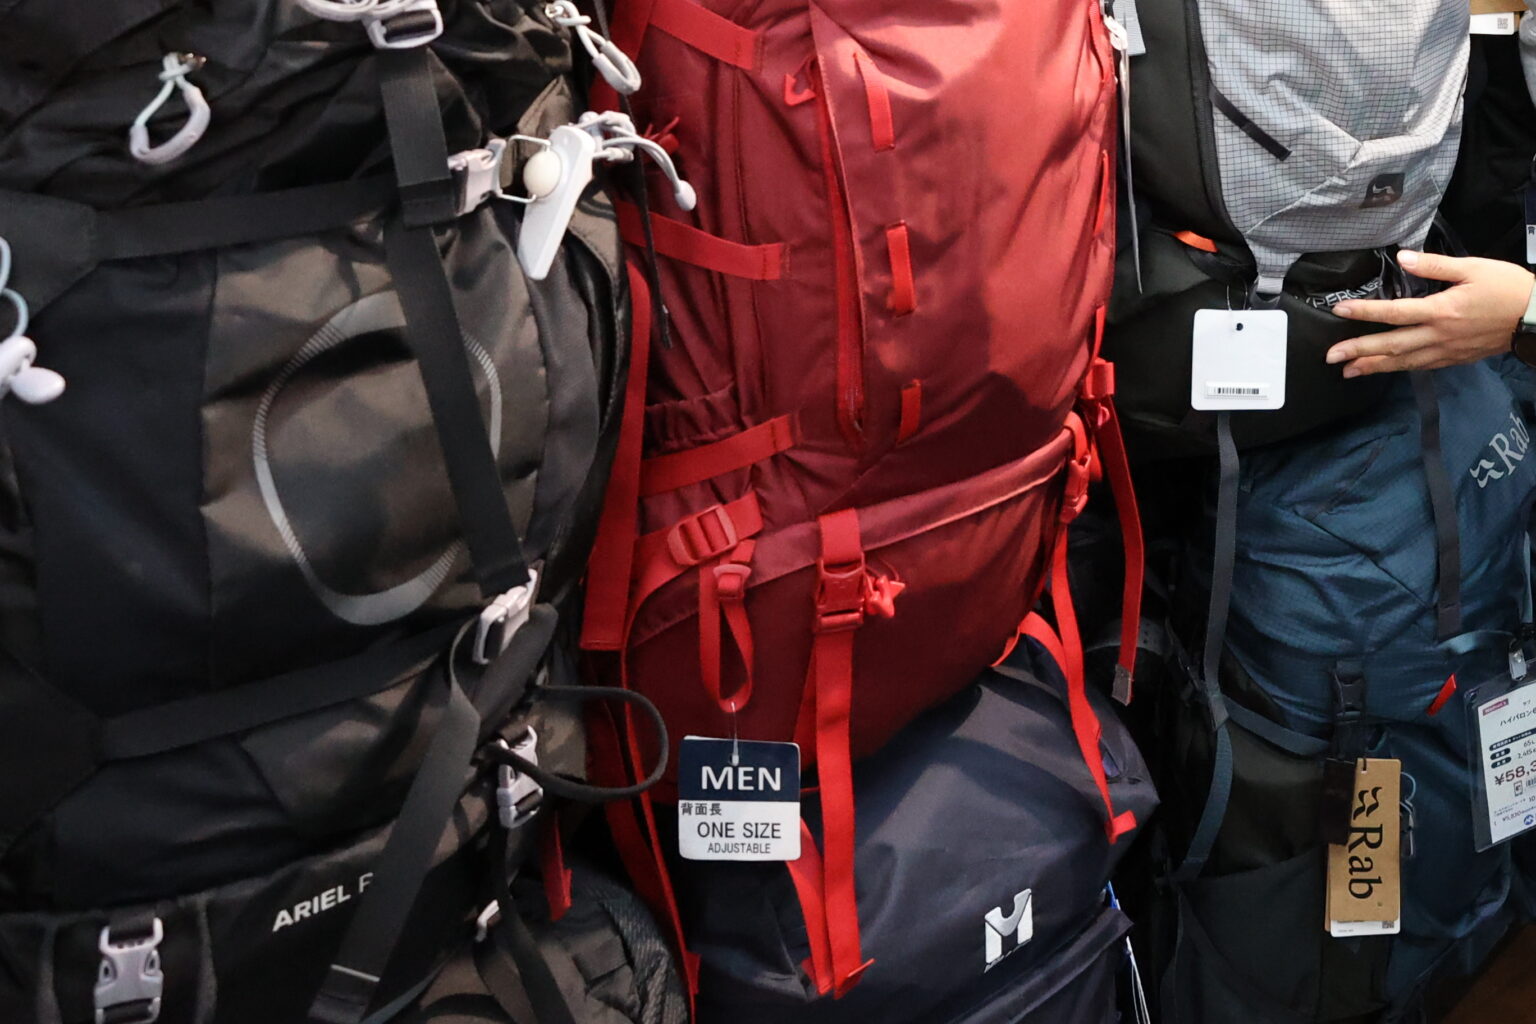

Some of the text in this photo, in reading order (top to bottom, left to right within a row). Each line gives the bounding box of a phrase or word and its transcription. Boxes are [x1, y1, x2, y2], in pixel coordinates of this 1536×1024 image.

[1489, 412, 1530, 476] Rab
[701, 765, 781, 791] MEN
[681, 803, 722, 816] 背面長
[697, 821, 782, 839] ONE SIZE
[707, 842, 771, 854] ADJUSTABLE
[1348, 823, 1383, 900] Rab
[272, 884, 352, 932] ARIEL
